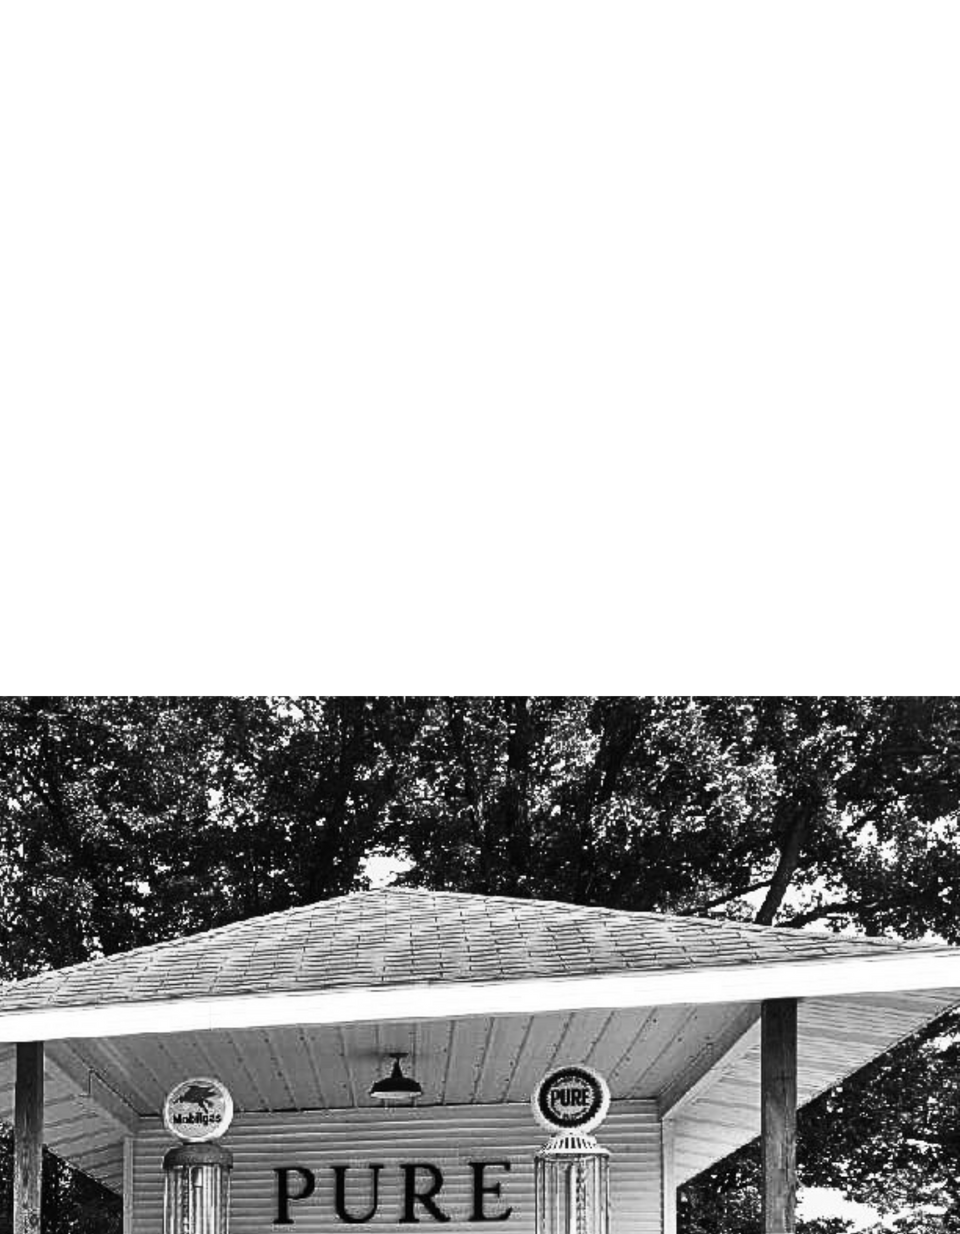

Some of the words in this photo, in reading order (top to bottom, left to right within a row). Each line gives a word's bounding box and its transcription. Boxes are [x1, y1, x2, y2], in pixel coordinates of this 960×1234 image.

[550, 1088, 590, 1108] PURE
[173, 1112, 222, 1126] Mobilgas
[273, 1161, 513, 1225] PURE
